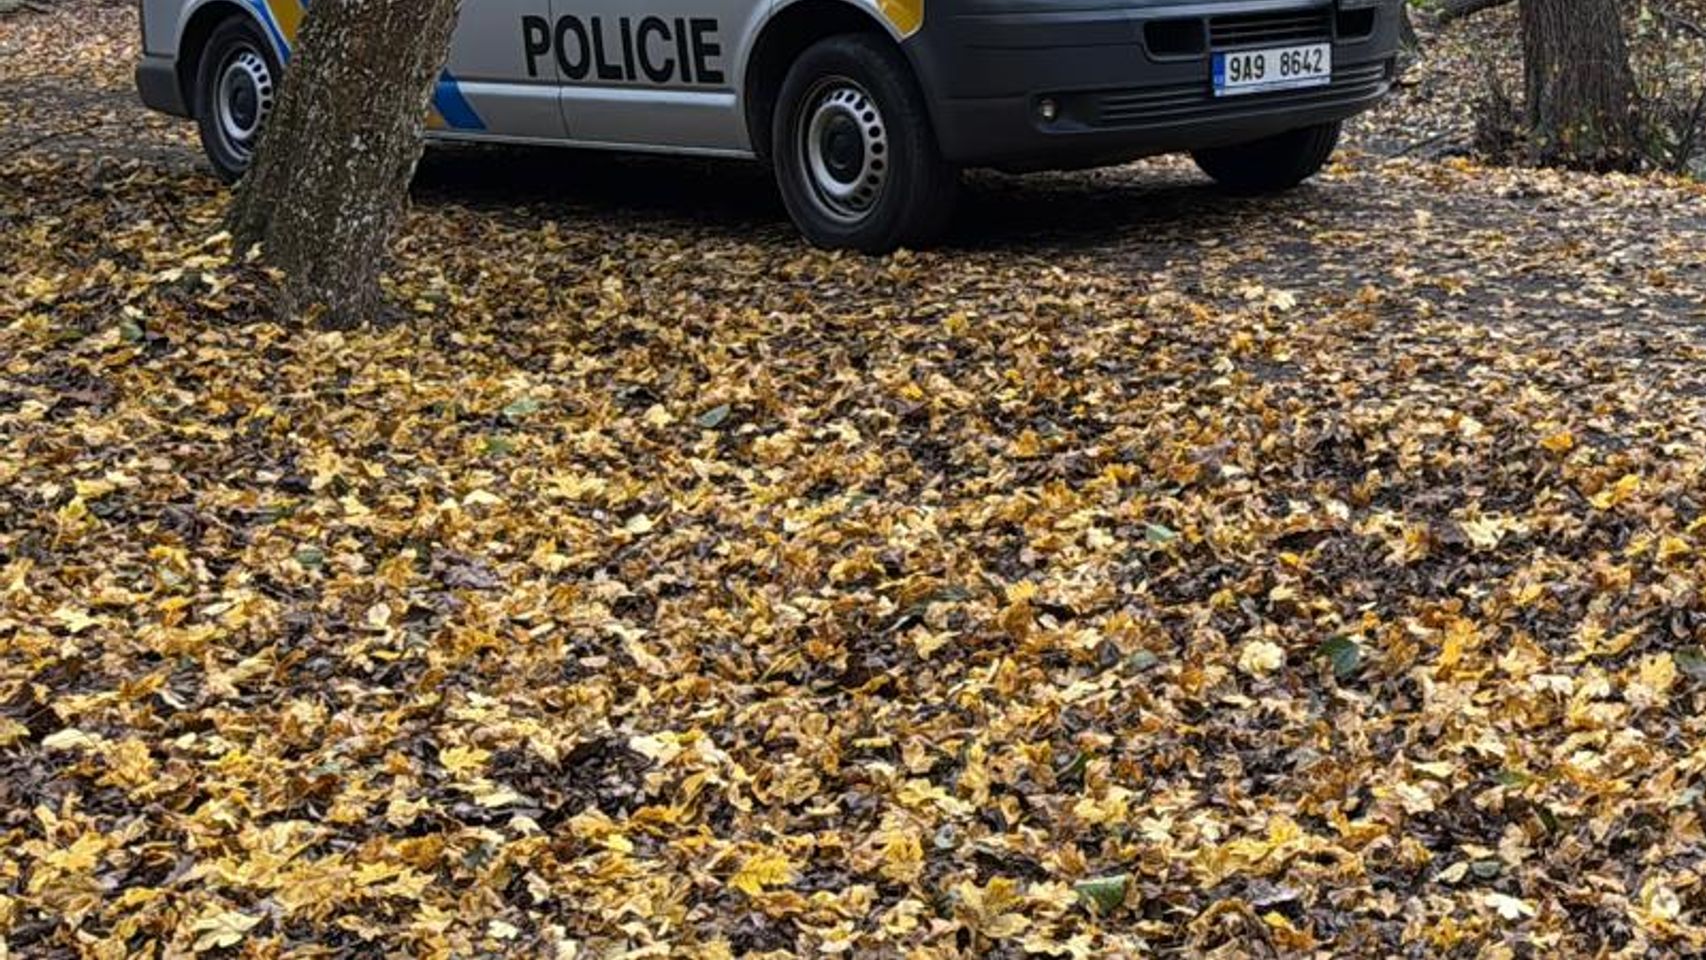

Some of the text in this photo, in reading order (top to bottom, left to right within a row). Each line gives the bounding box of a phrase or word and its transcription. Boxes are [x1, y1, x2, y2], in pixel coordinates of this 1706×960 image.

[521, 14, 724, 84] POLICIE
[1230, 47, 1323, 82] 9A9 8642
